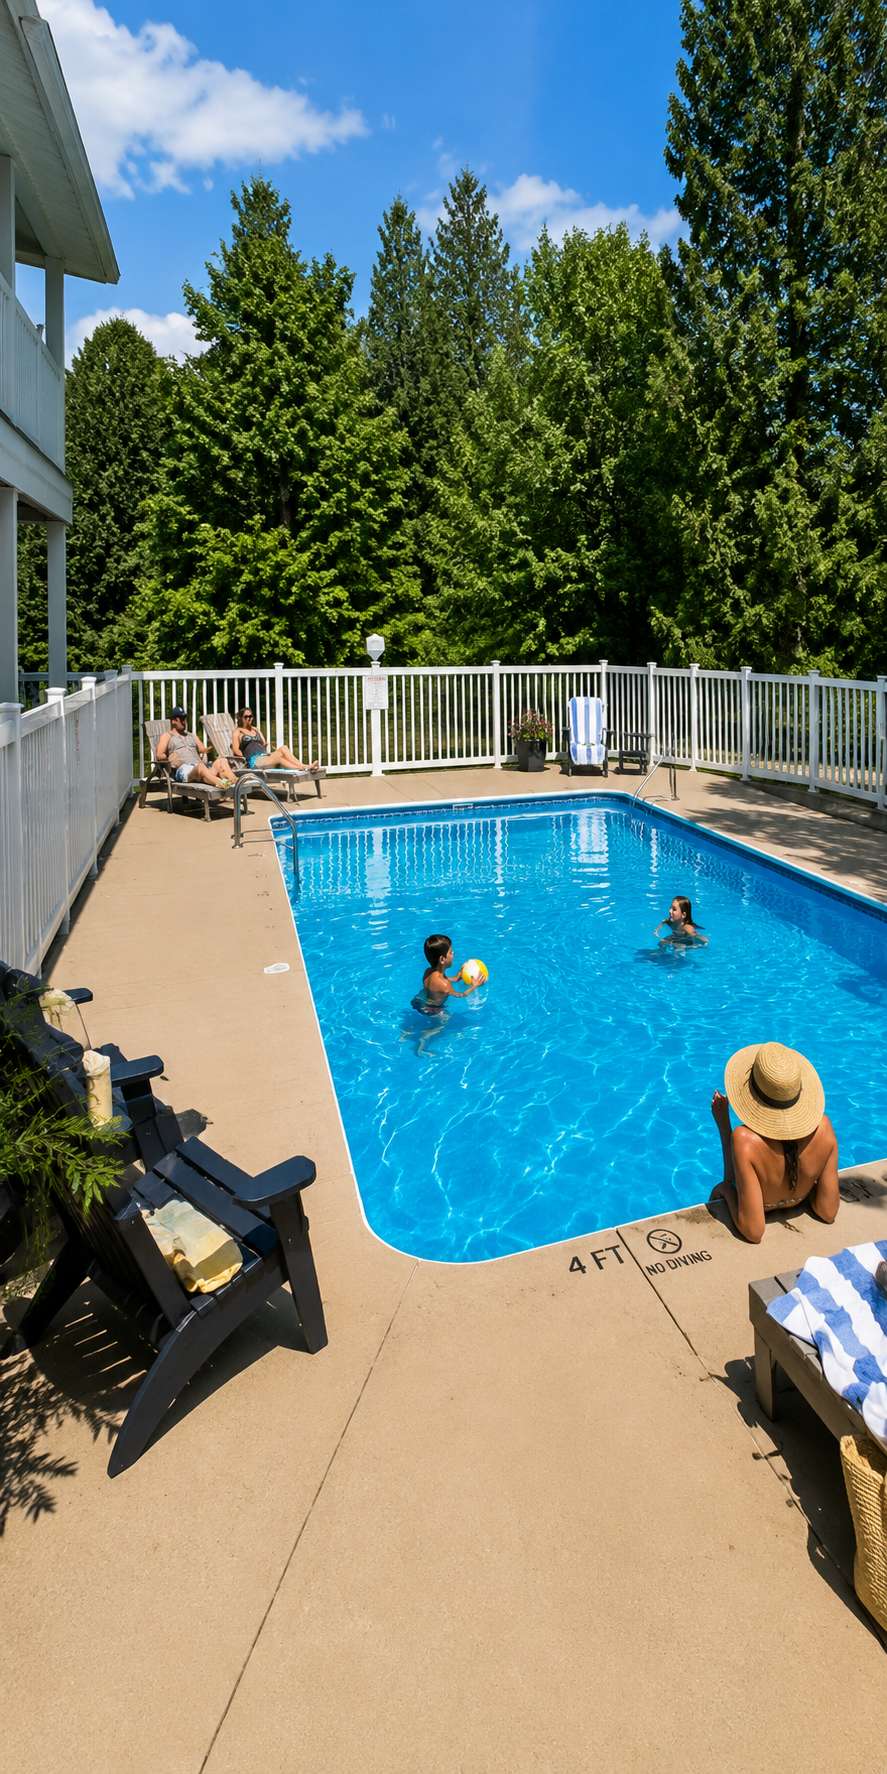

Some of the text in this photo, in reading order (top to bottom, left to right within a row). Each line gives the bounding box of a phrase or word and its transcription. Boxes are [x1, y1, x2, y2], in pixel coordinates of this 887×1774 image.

[568, 1245, 625, 1274] 4 FT
[645, 1250, 713, 1276] NO DIVING
